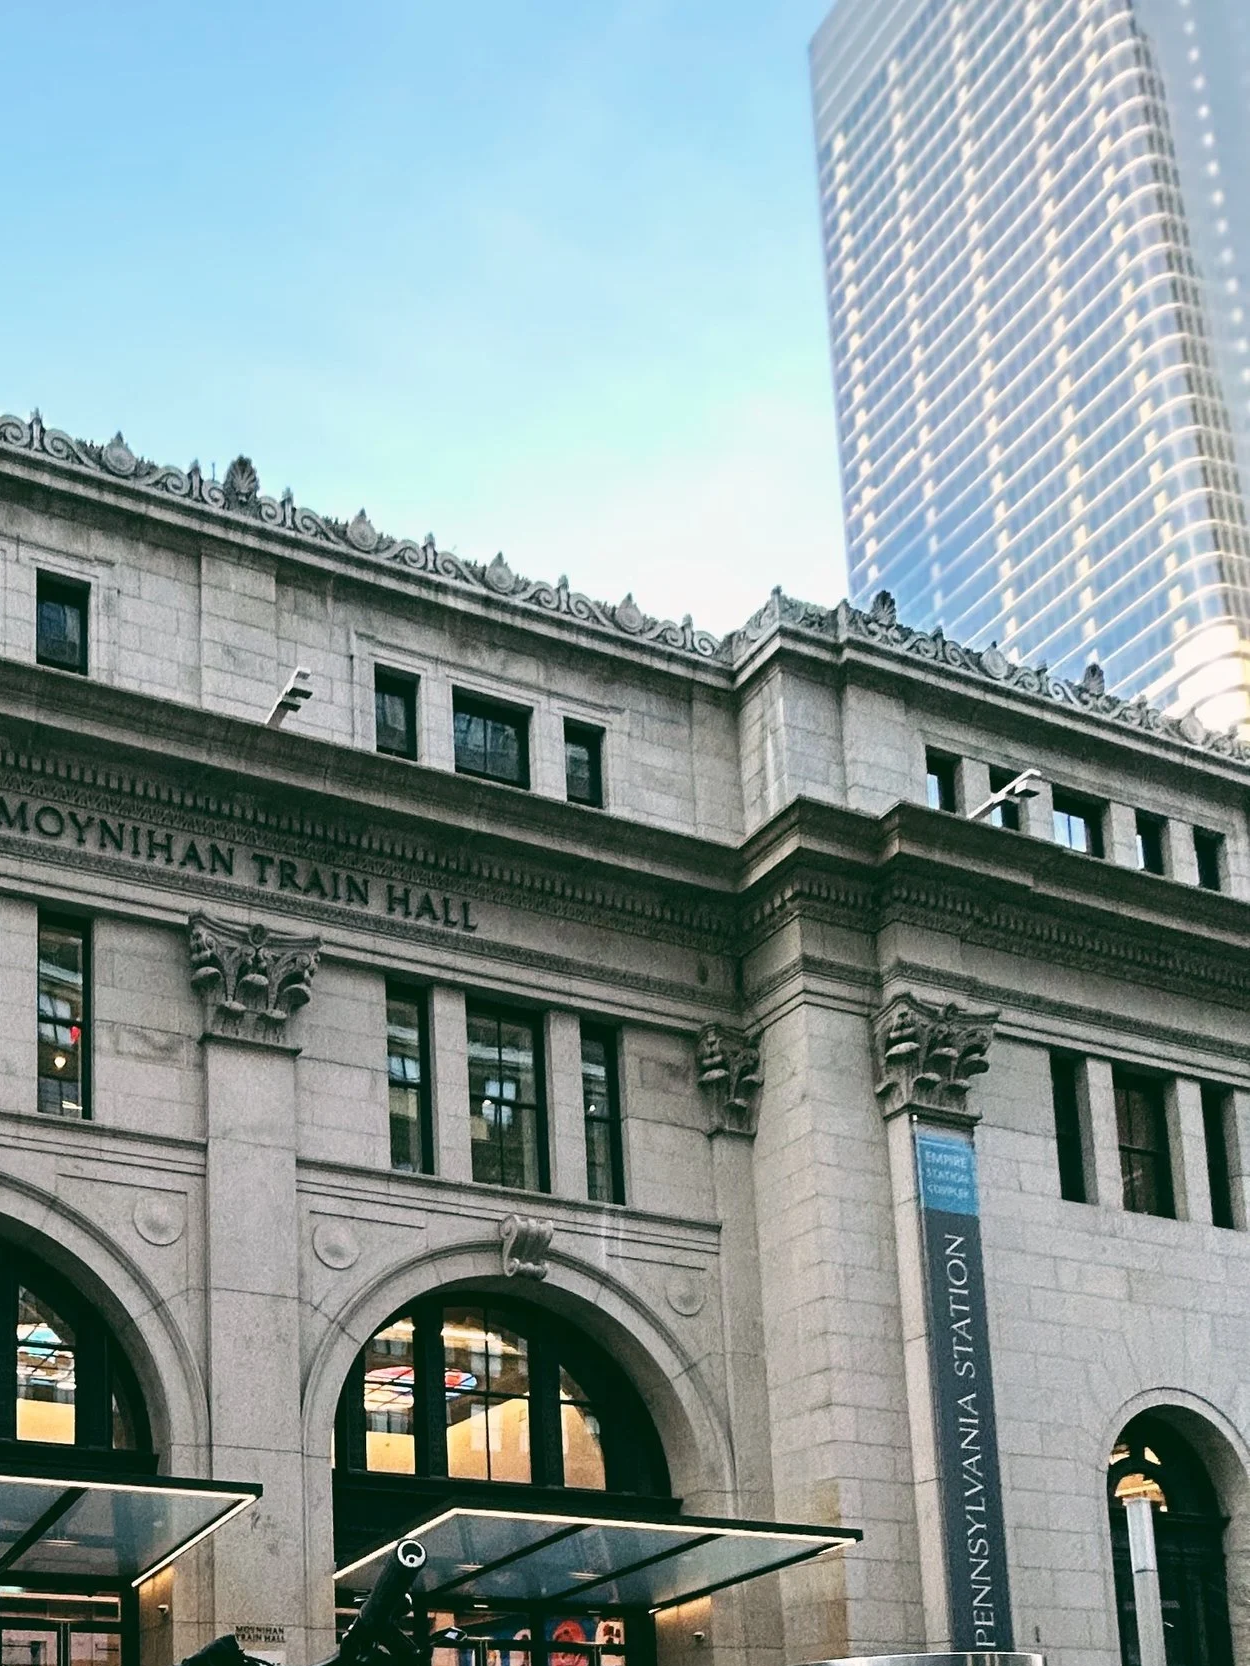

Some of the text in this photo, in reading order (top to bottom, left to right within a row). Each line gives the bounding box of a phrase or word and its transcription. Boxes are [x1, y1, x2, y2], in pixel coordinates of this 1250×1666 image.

[252, 854, 370, 906] TRAIN
[386, 883, 479, 931] HALL
[944, 1233, 997, 1650] PENNSYLVANIA STATION
